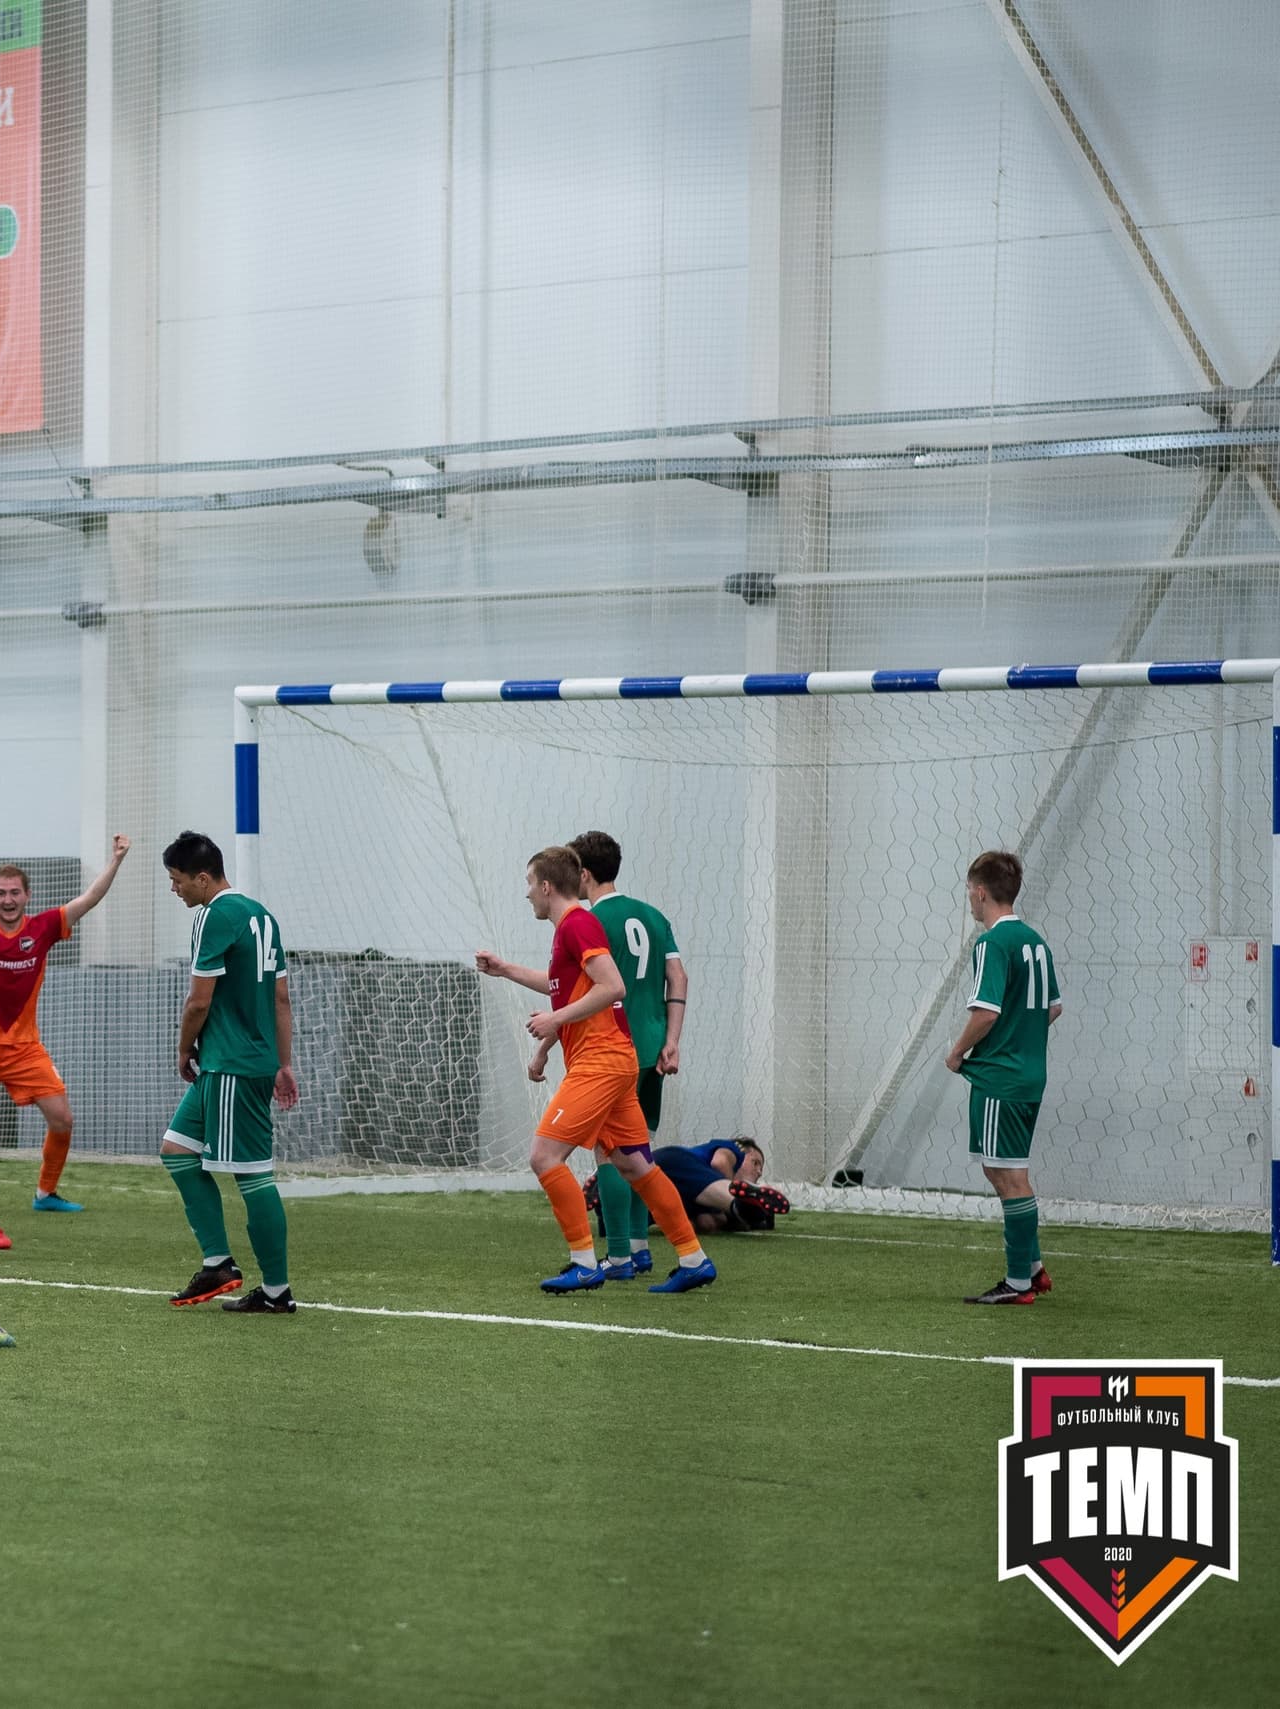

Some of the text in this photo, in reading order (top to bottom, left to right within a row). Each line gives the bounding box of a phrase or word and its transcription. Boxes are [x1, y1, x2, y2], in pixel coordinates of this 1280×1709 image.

[249, 914, 278, 982] 14
[624, 917, 650, 980] 9
[1022, 944, 1049, 1009] 11
